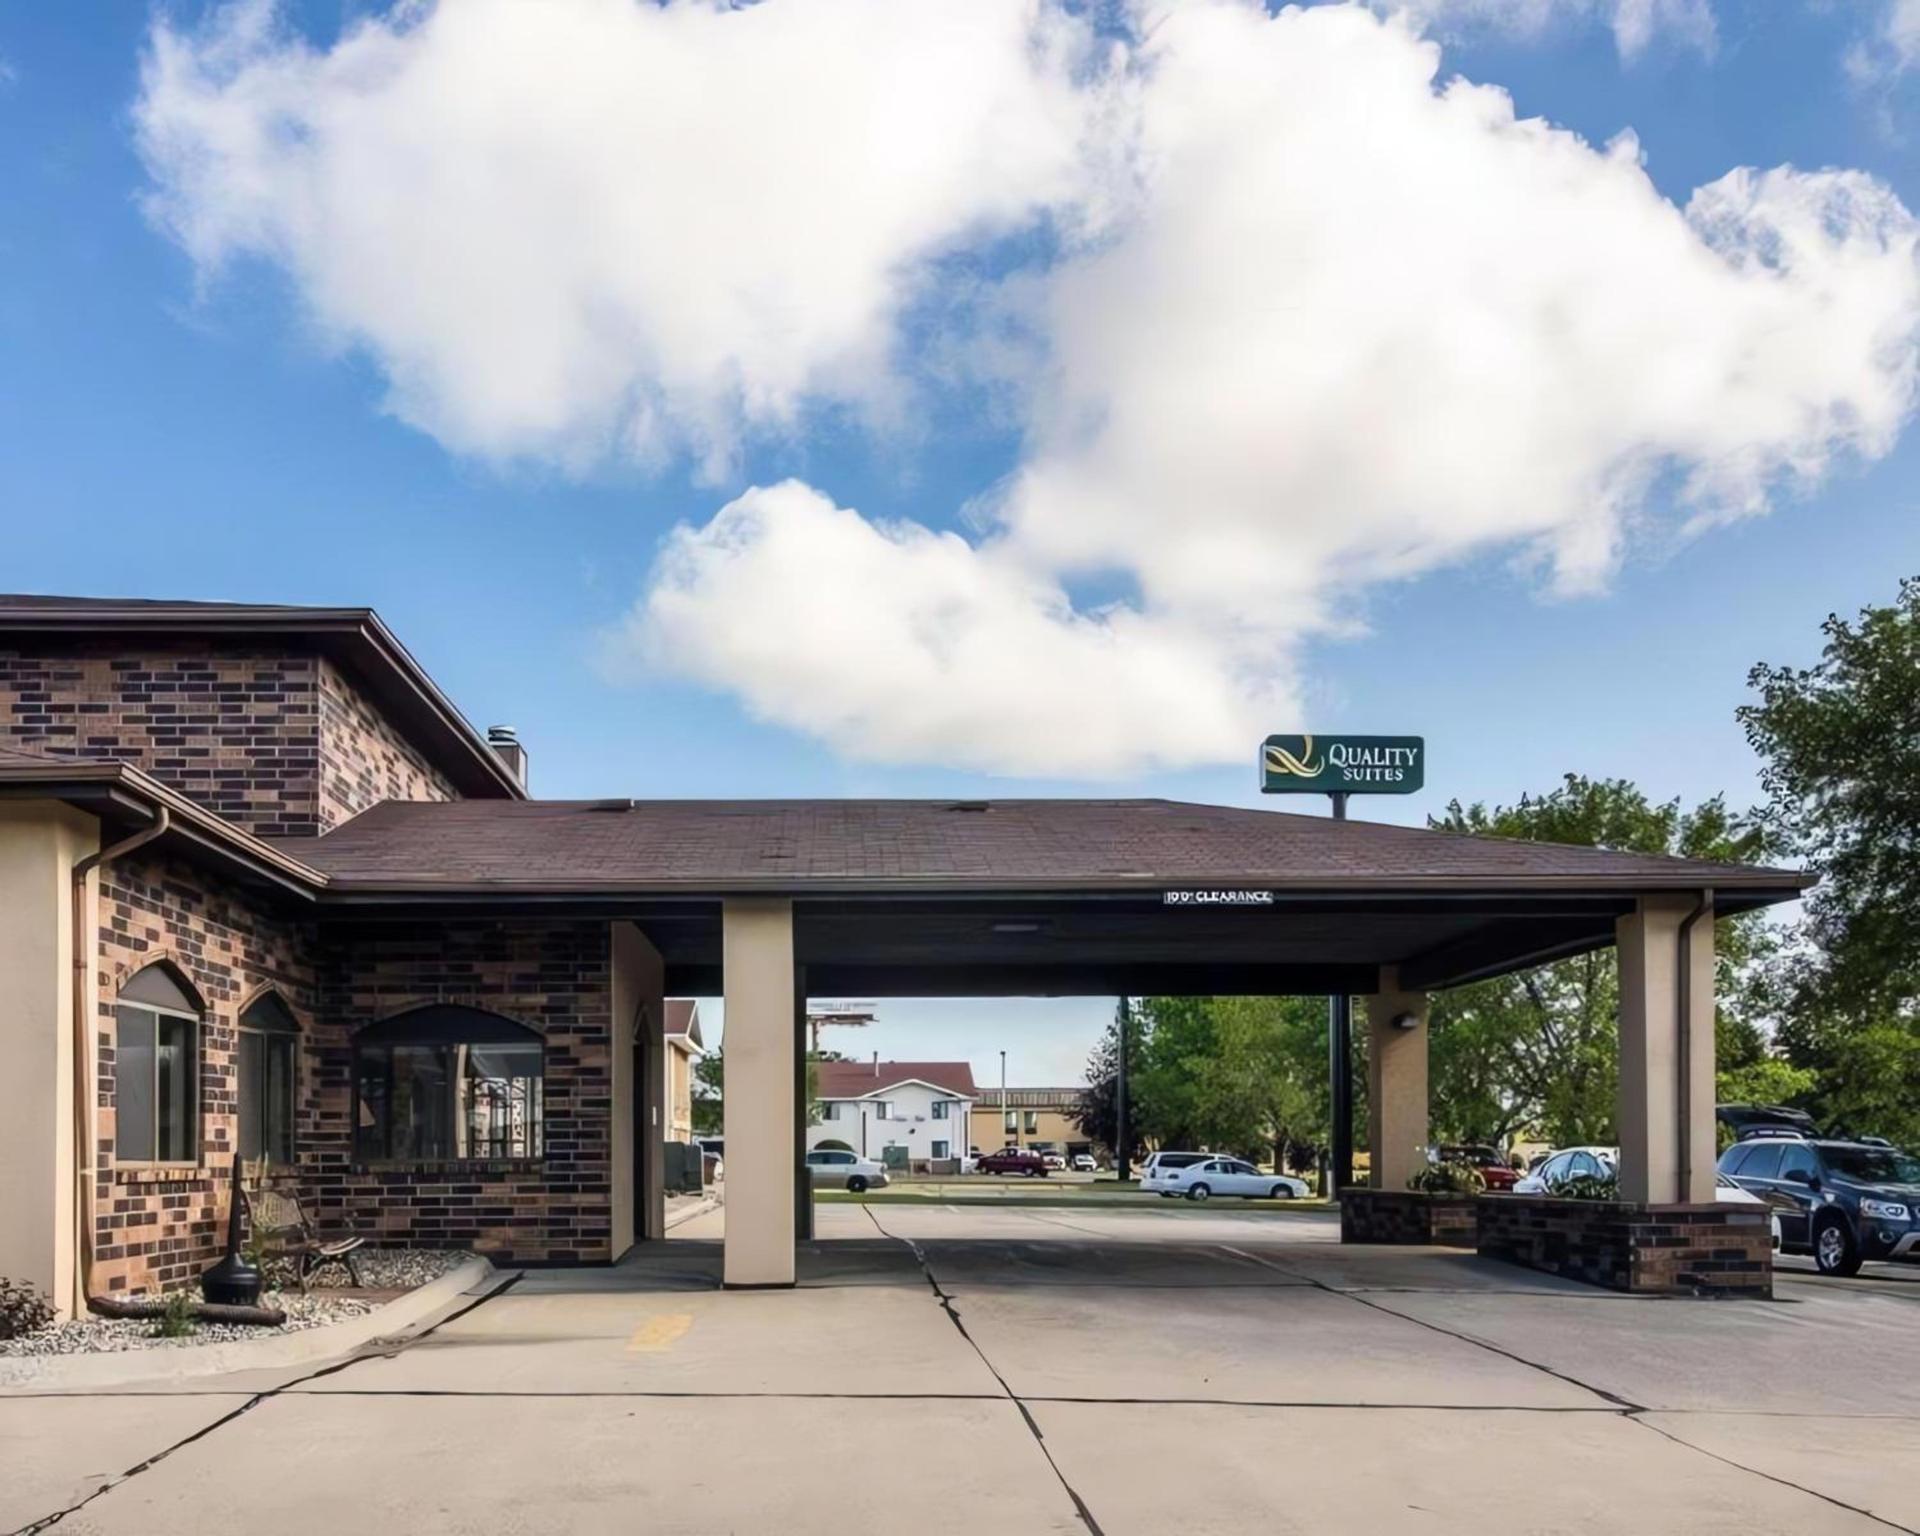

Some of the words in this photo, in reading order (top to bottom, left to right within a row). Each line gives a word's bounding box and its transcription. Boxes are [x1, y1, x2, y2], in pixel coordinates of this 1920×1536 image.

[1329, 743, 1417, 767] QUALITY
[1343, 767, 1404, 781] SUITES
[1195, 891, 1273, 903] CLEARANCE
